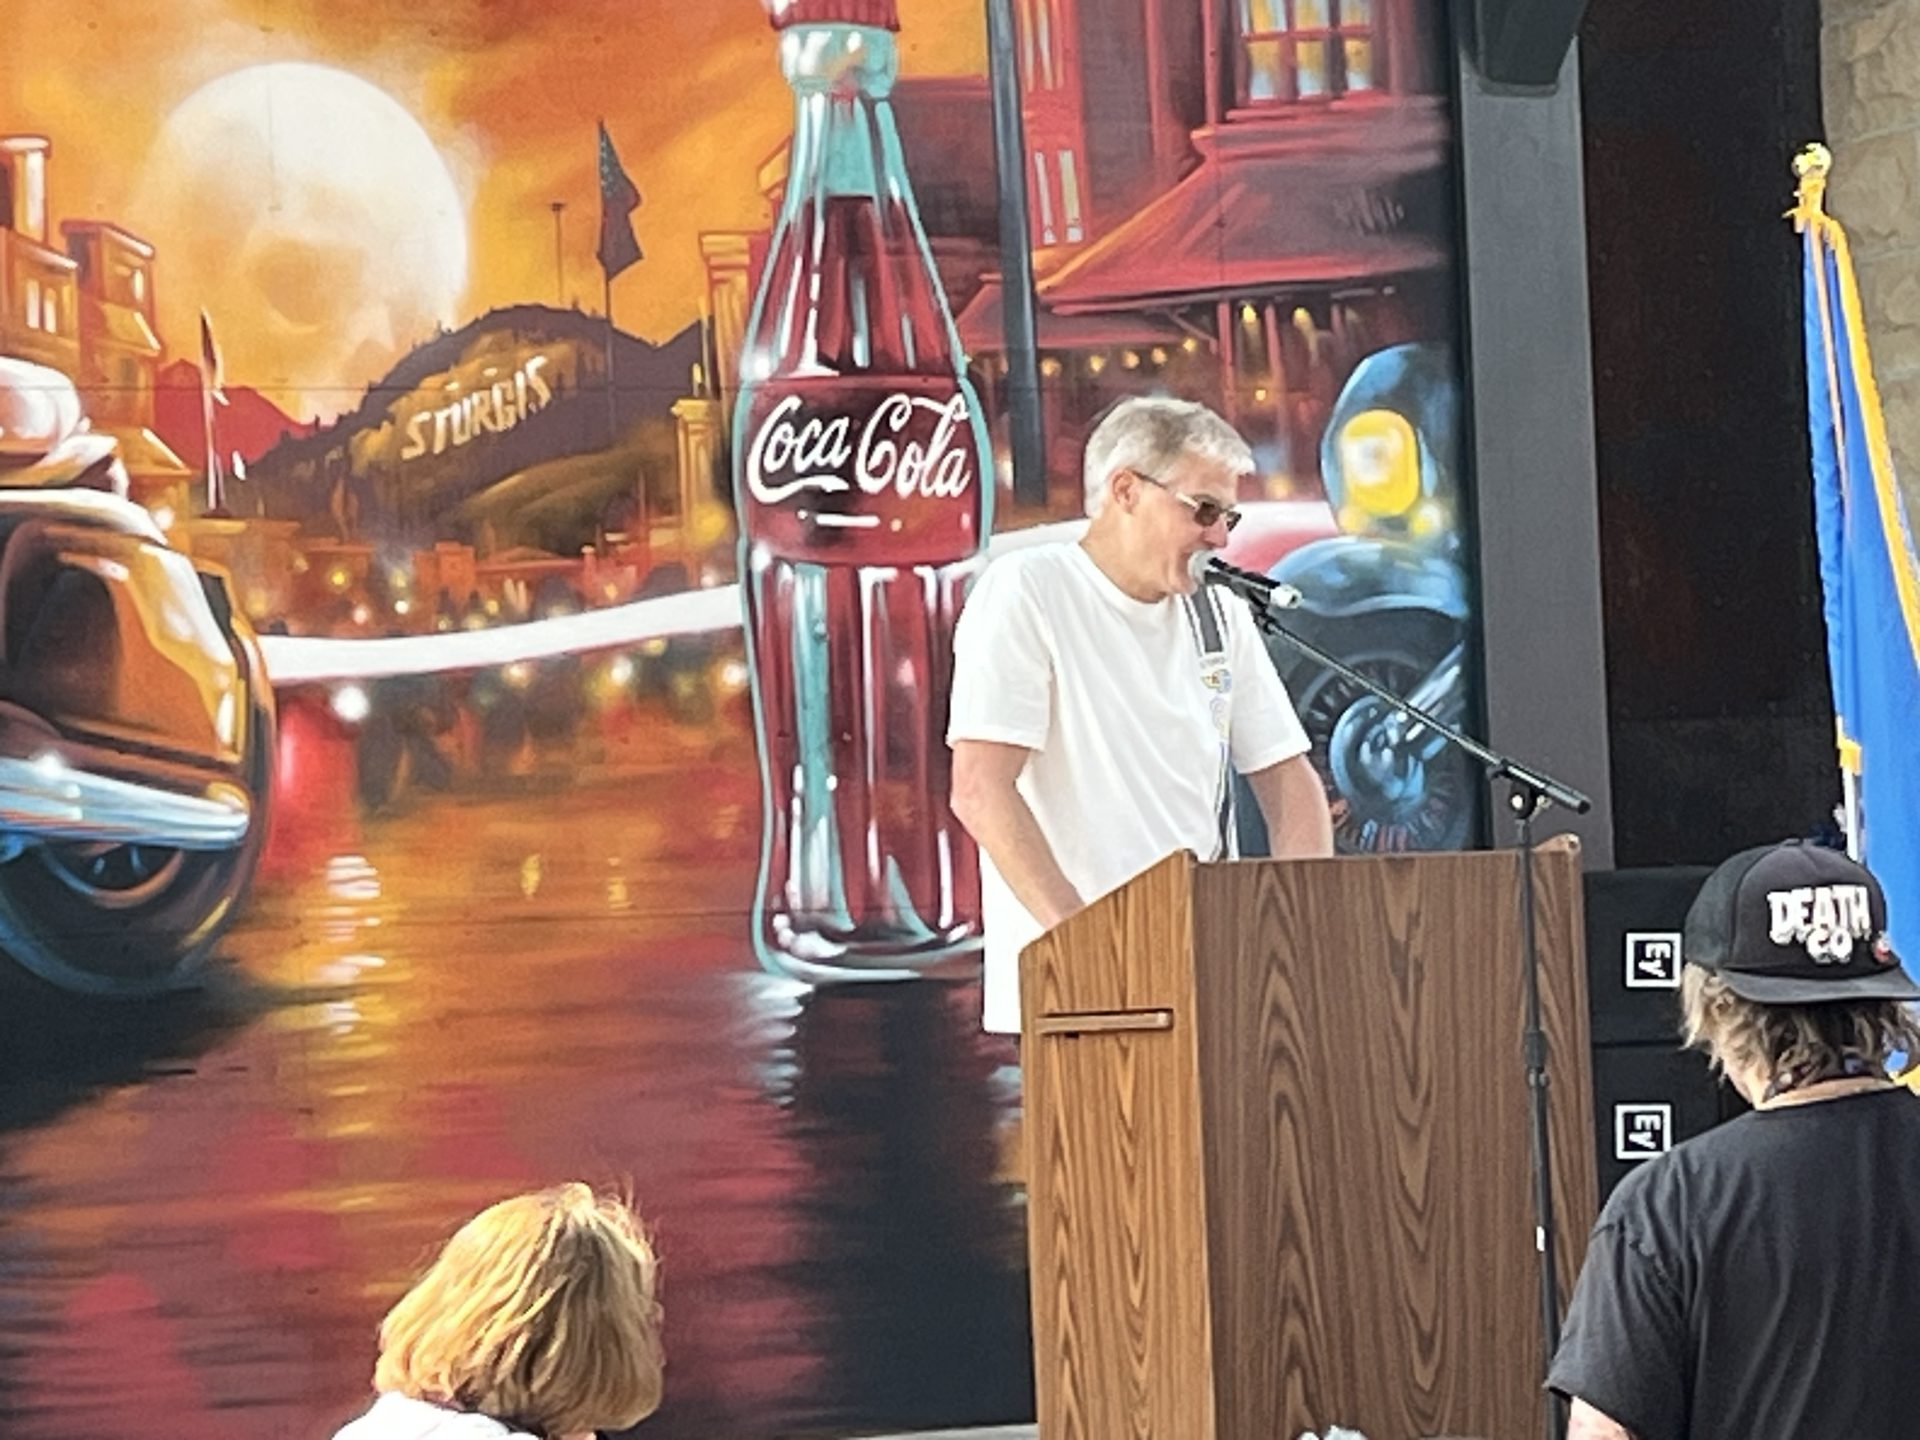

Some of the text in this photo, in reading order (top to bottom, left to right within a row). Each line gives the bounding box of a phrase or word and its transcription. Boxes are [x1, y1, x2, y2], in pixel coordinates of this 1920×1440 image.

[402, 356, 551, 460] STURGIS
[747, 393, 971, 503] Coca Cola
[1766, 885, 1872, 944] DEATH
